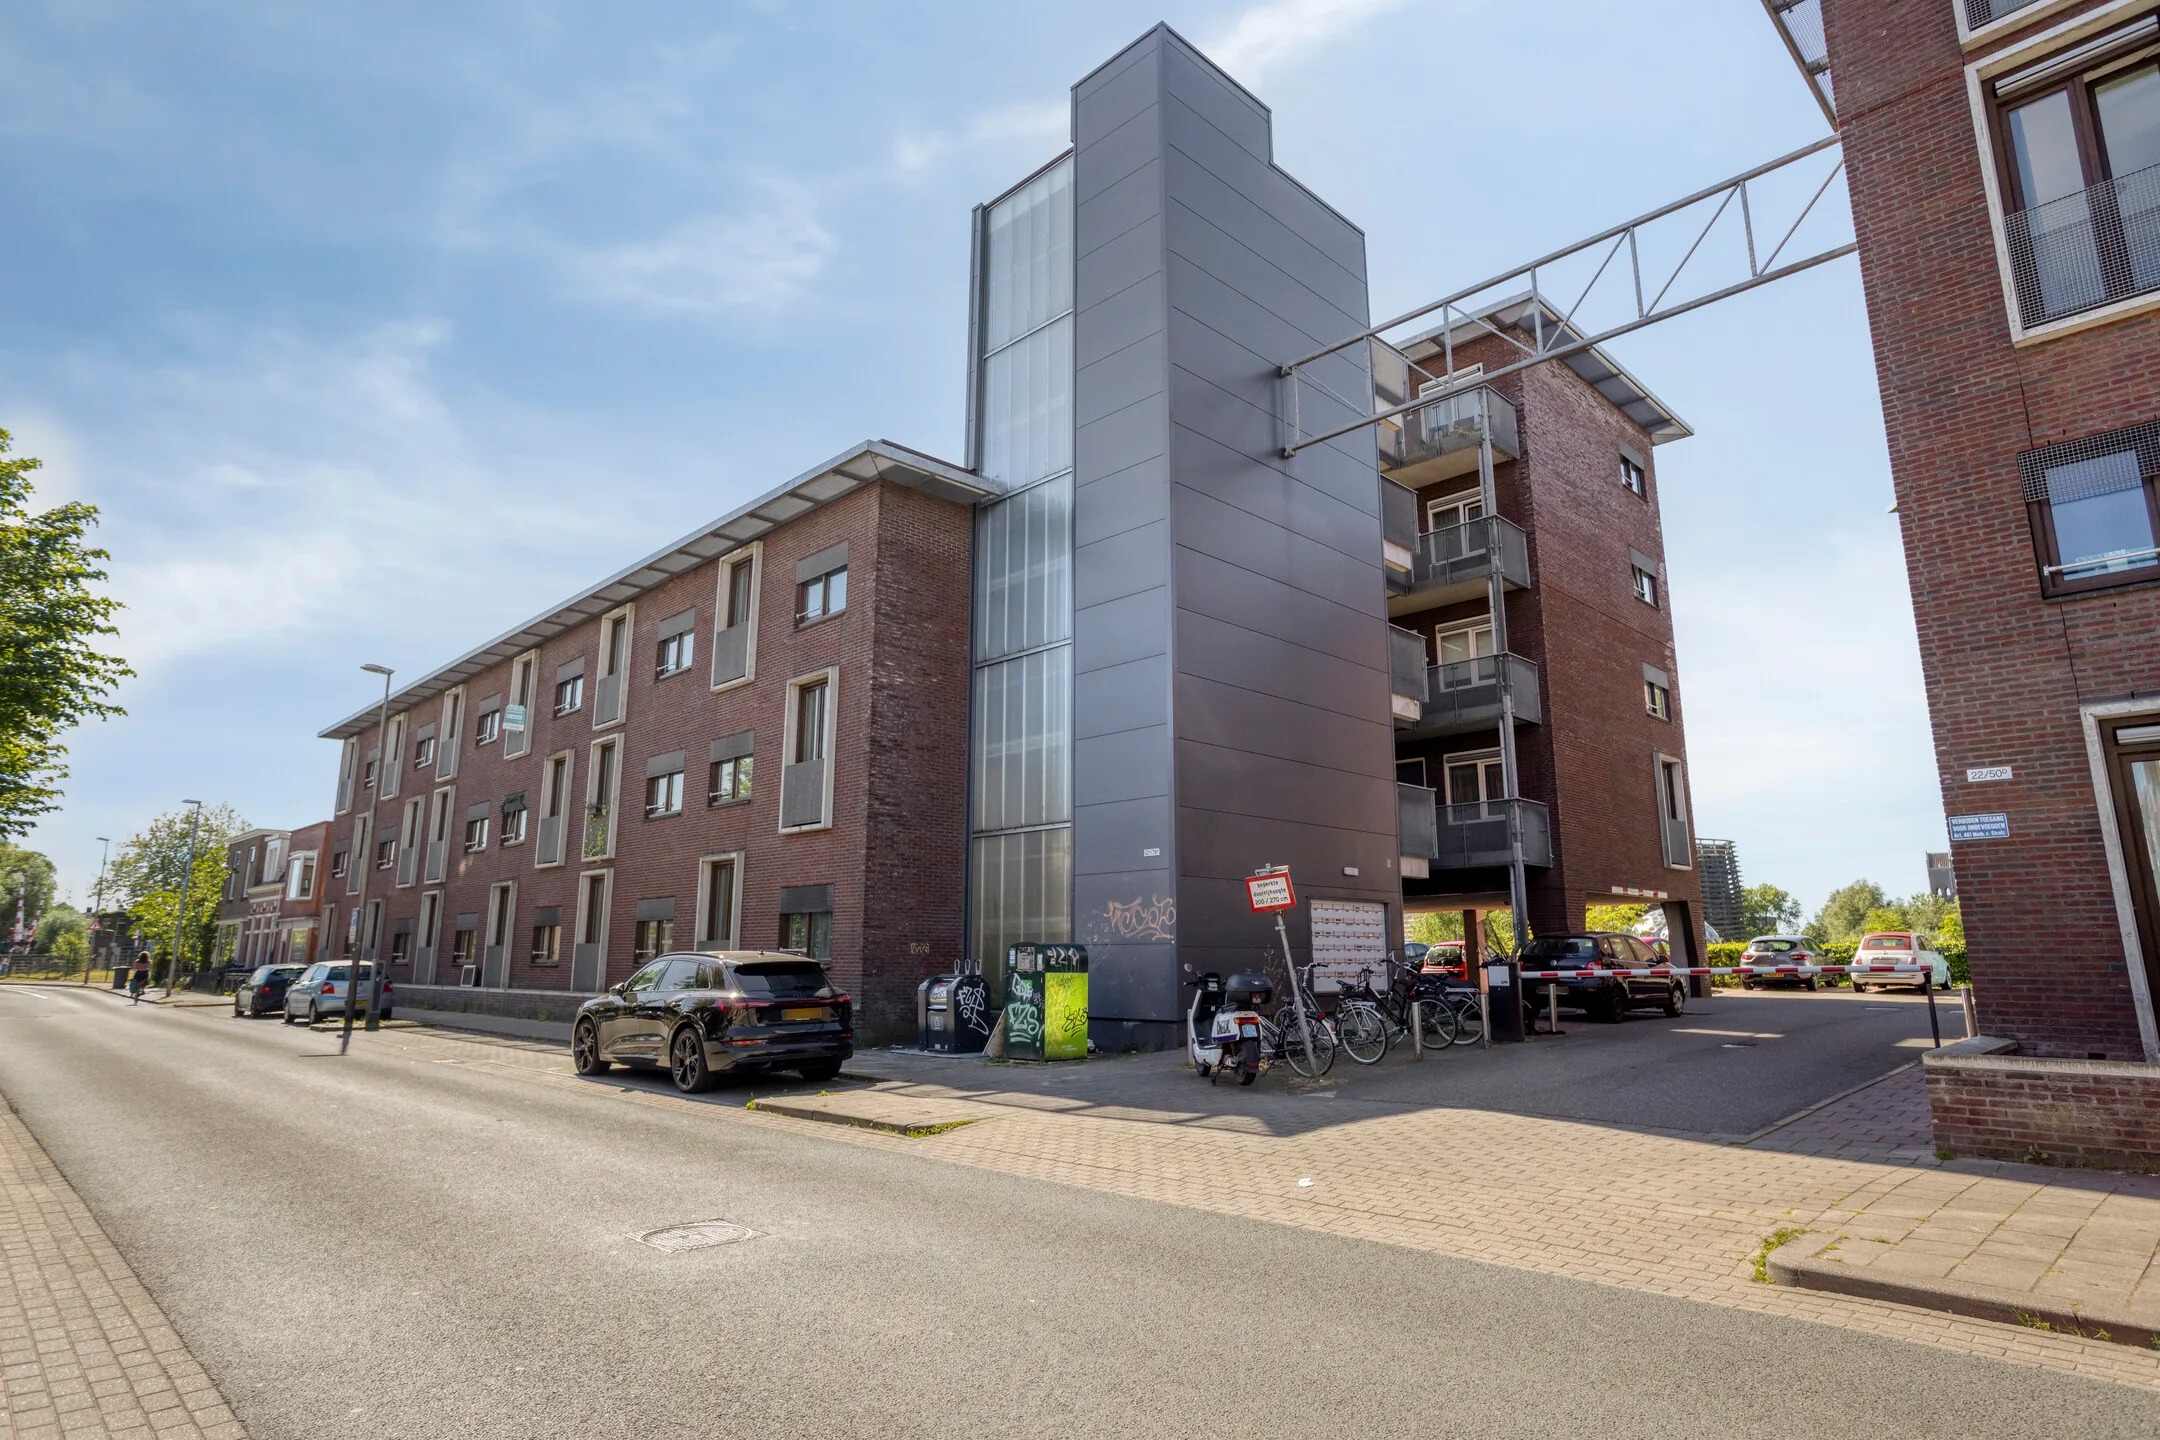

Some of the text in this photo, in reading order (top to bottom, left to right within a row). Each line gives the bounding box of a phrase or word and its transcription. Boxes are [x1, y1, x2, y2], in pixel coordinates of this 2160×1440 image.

[1951, 815, 2004, 825] VERBODEN TOEGANG
[1952, 822, 2006, 832] VOOR ONBEVOEGDEN
[1256, 880, 1279, 888] beperkte
[1253, 888, 1286, 897] doorrijhoogte
[1255, 898, 1265, 906] 200
[1269, 896, 1280, 904] 270
